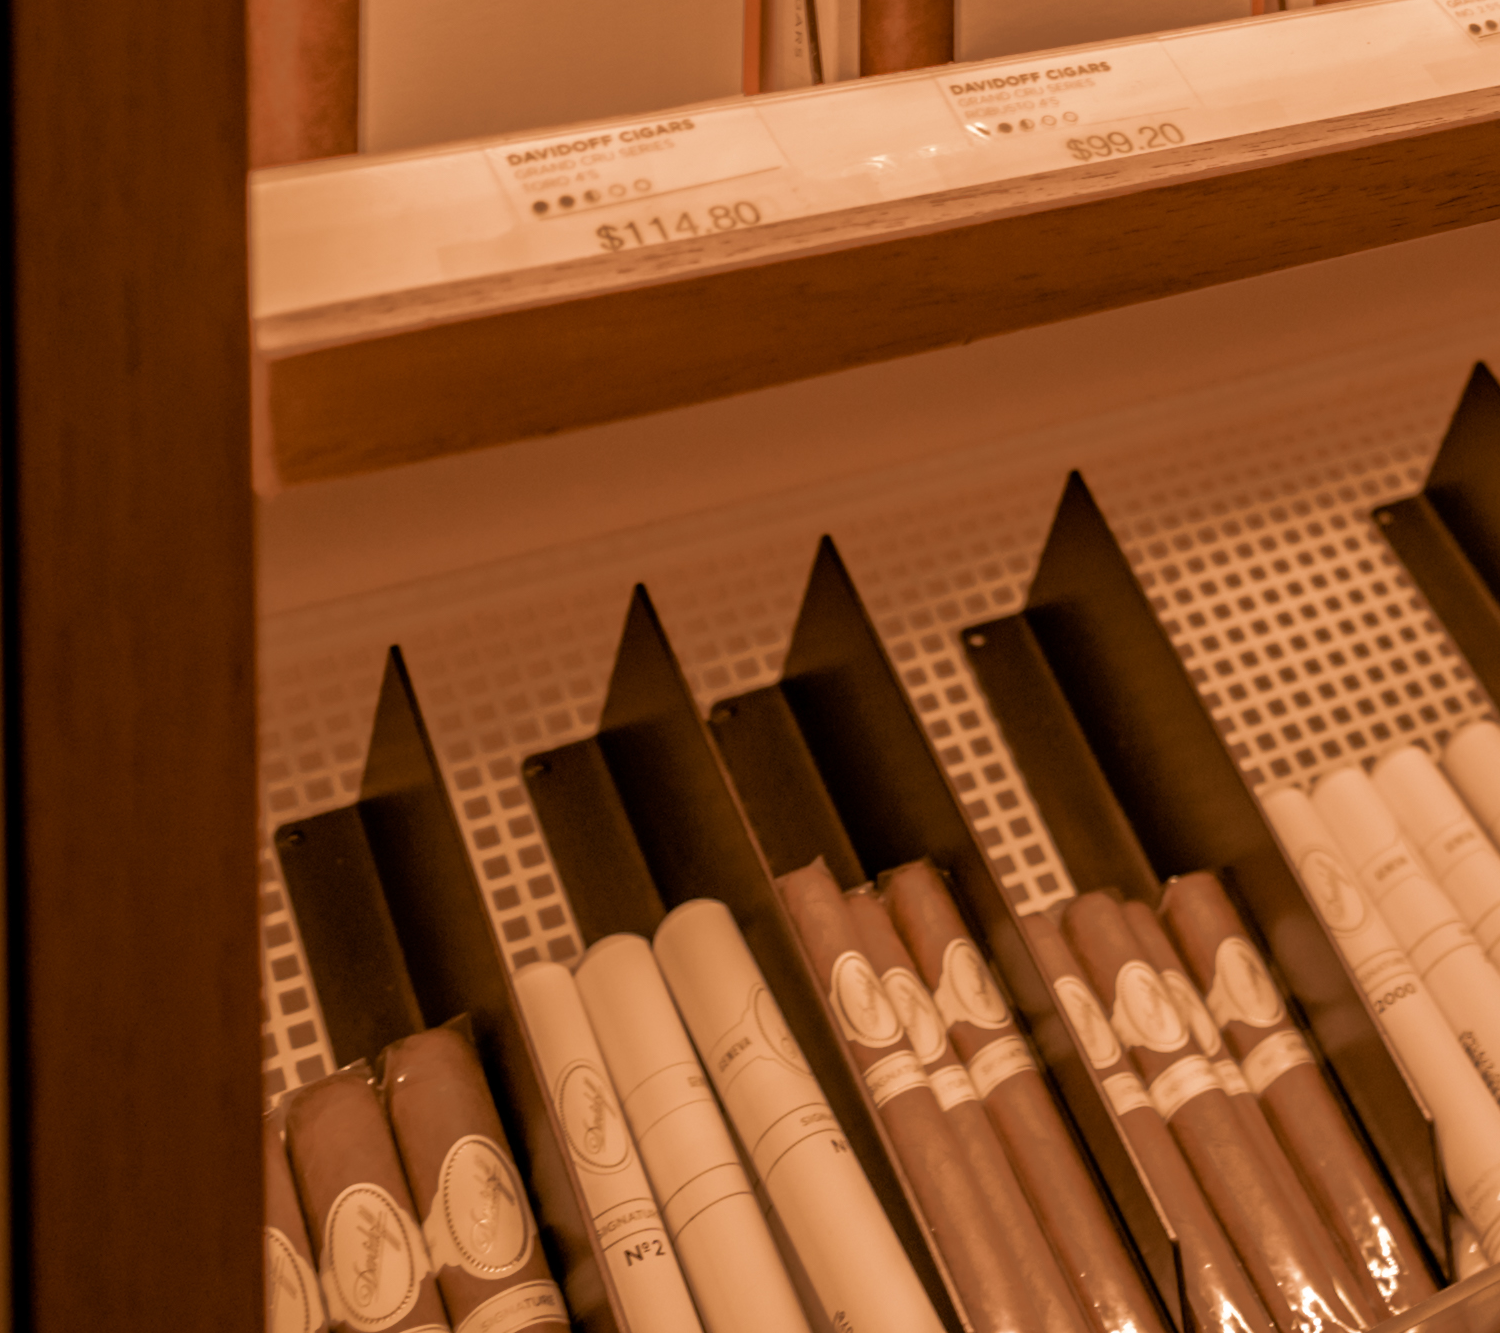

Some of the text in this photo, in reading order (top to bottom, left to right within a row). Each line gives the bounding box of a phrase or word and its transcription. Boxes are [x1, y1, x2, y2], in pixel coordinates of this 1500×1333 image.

[950, 61, 1111, 96] DAVIDOFF CIGARS
[507, 118, 695, 166] DAVIDOFF CIGARS
[1066, 122, 1185, 161] $99.20
[596, 201, 761, 252] $114.80
[623, 1239, 666, 1268] Nº2
